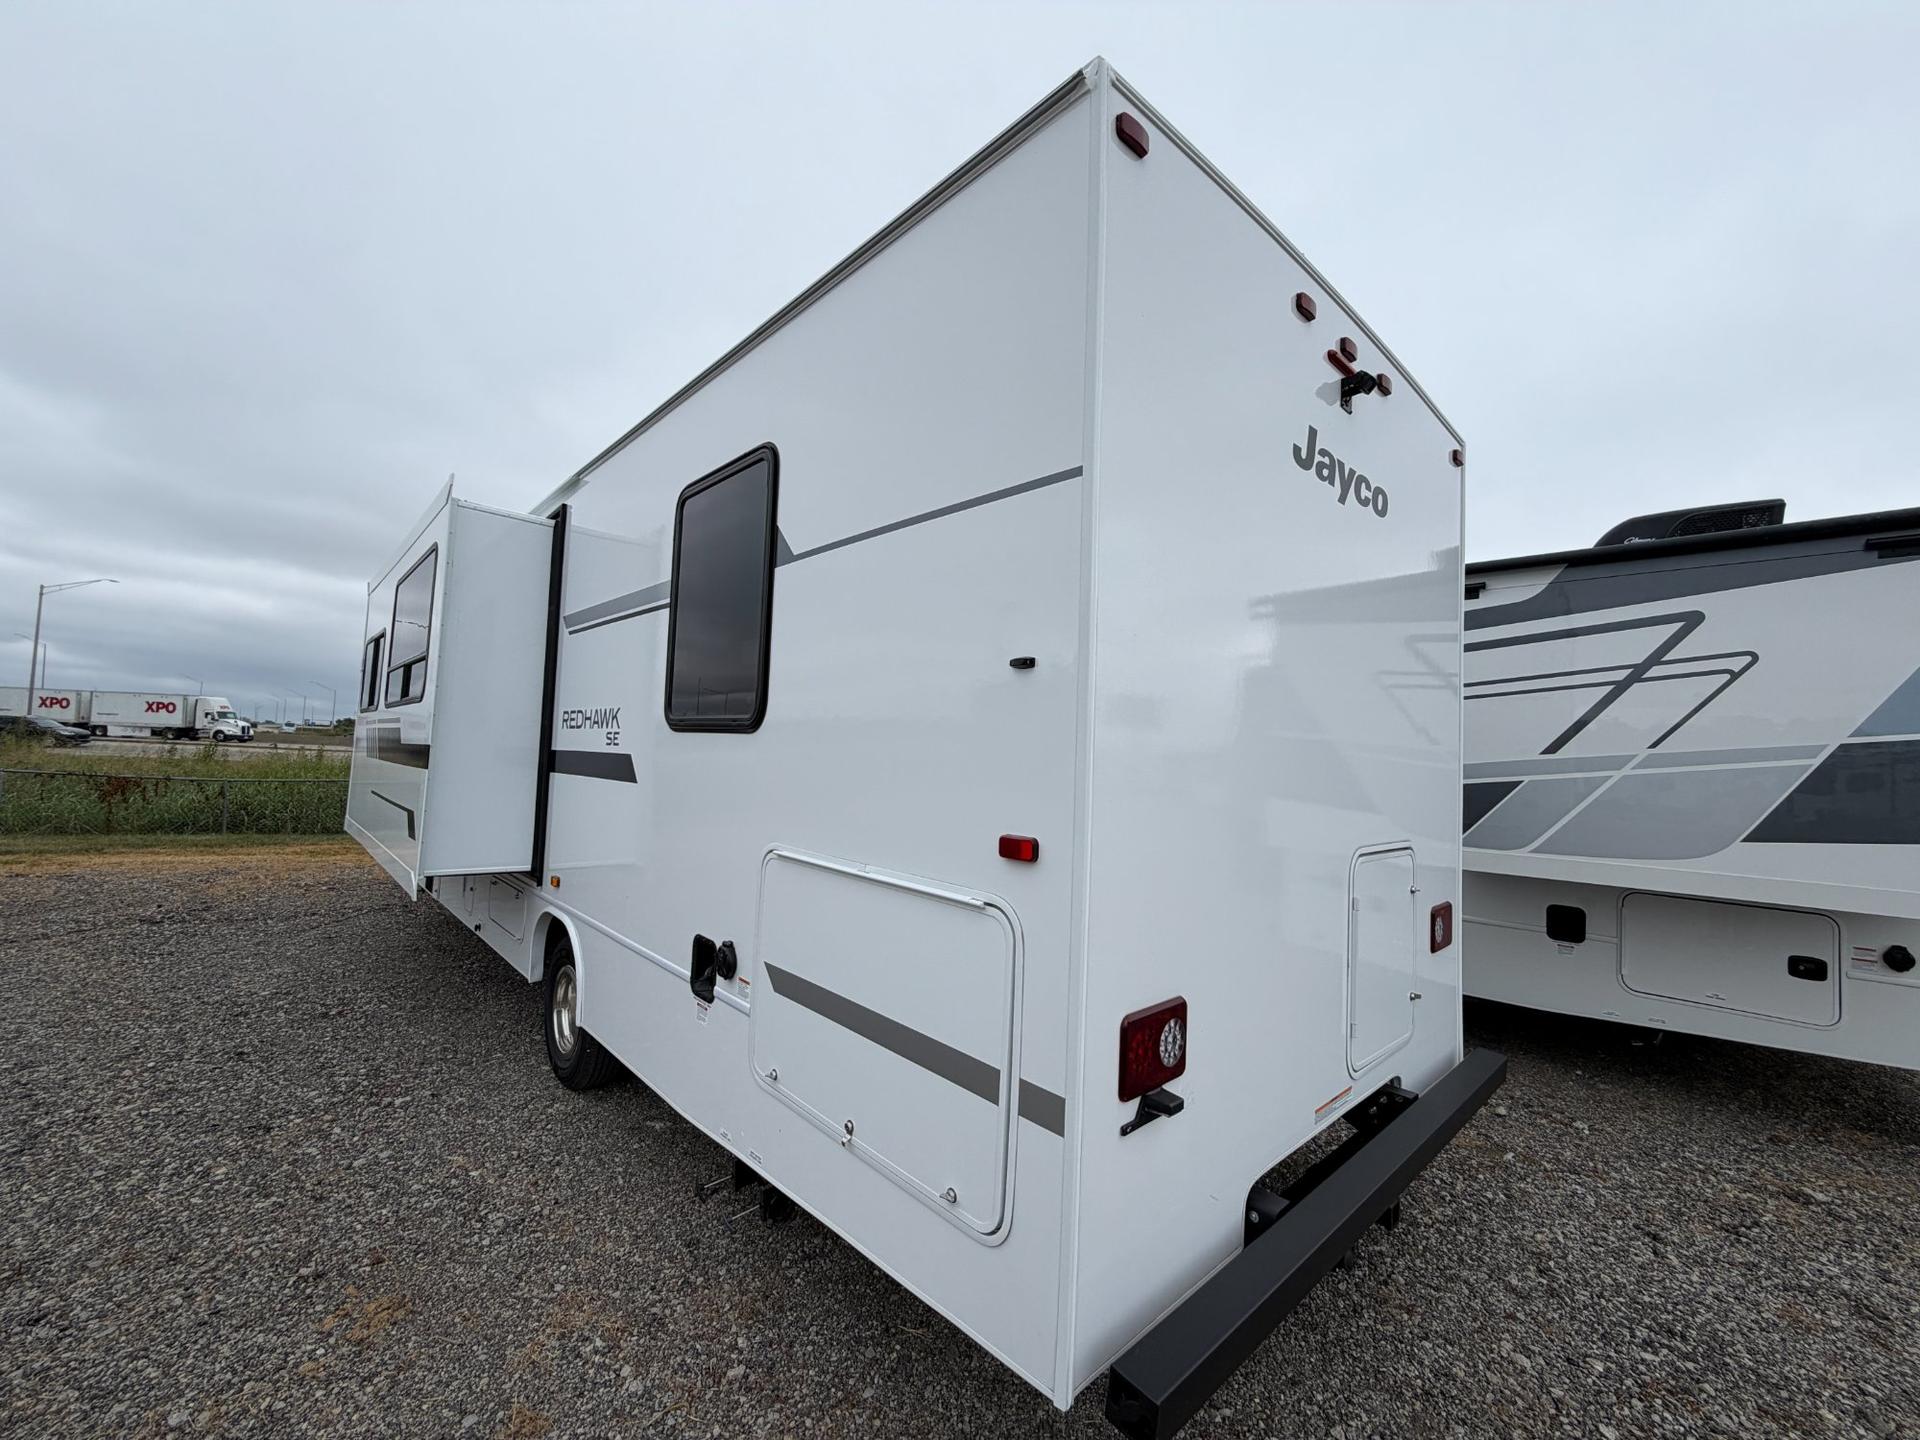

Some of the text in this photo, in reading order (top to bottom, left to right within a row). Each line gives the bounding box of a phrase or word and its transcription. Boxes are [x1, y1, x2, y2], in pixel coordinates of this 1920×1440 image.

[1293, 425, 1388, 518] Jayco
[38, 696, 71, 709] XPO
[144, 701, 177, 714] XPO
[562, 707, 621, 730] REDHAWK
[605, 732, 620, 746] SE
